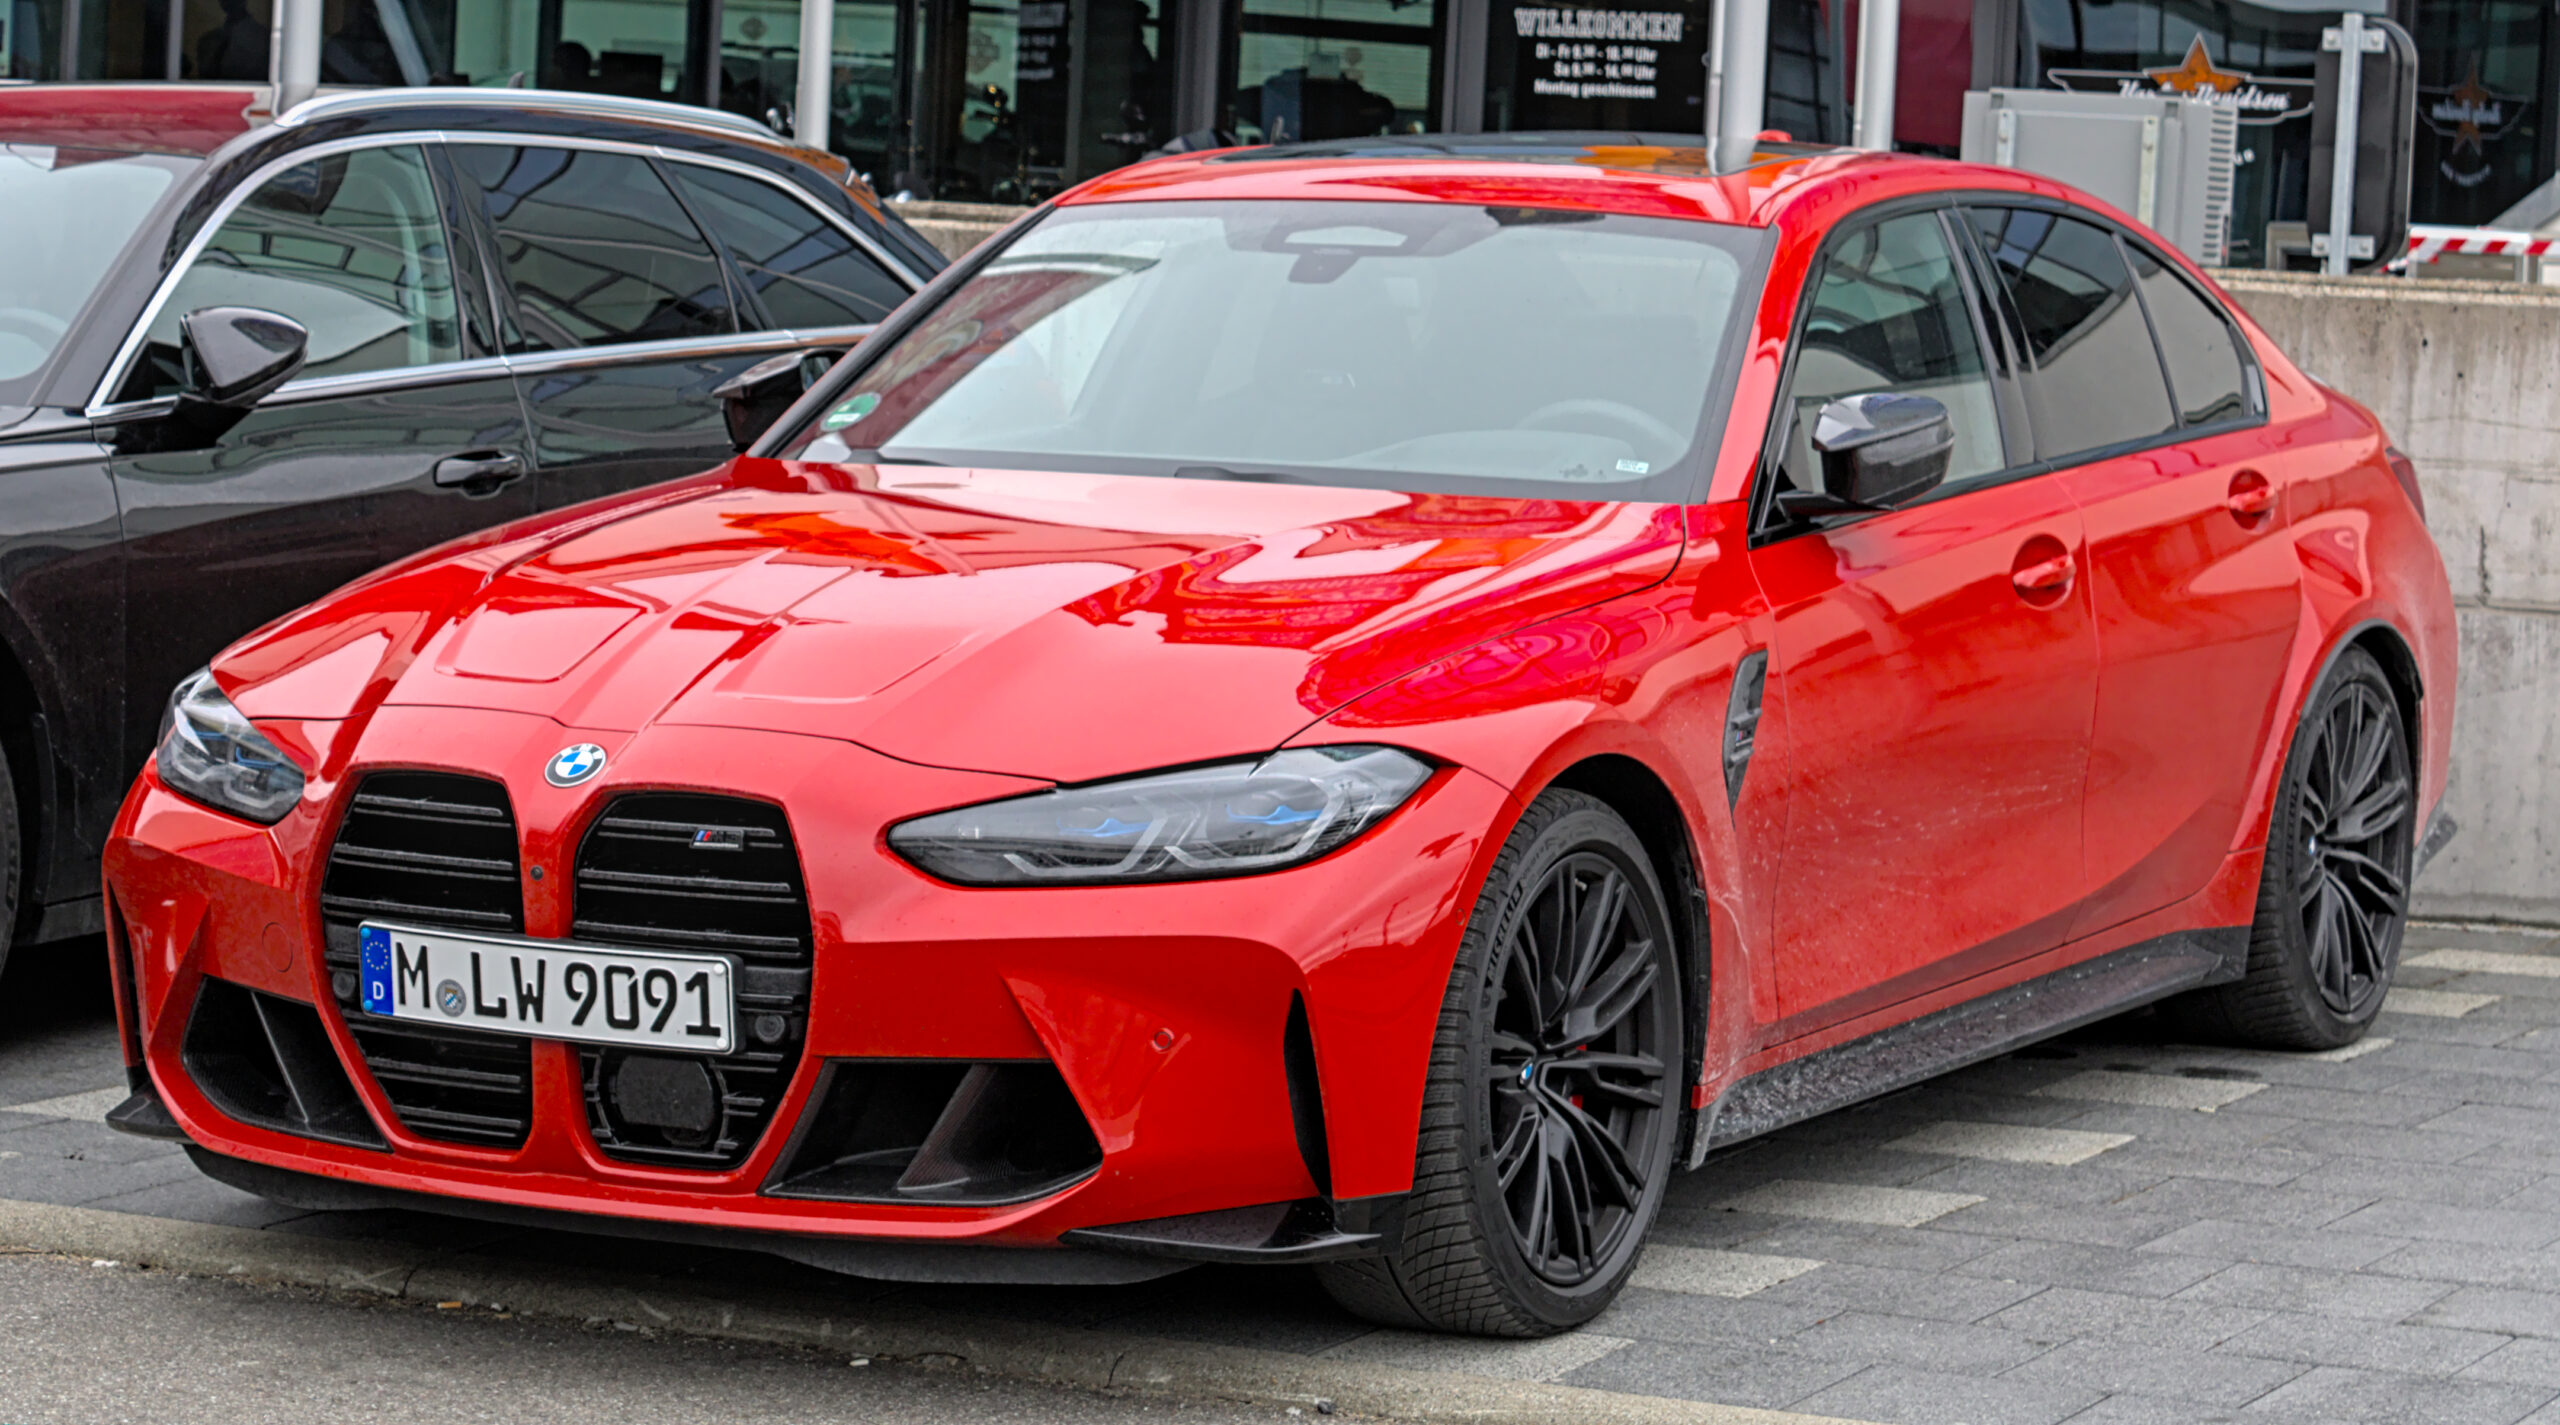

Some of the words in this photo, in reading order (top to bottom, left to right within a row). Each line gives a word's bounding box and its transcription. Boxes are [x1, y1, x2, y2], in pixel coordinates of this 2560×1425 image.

[1514, 8, 1683, 41] WILLKOMMEN
[1635, 47, 1657, 62] Uhr
[1554, 61, 1570, 77] Sa
[1634, 65, 1657, 80] Uhr
[1534, 79, 1579, 98] Montag
[1581, 82, 1657, 98] geschlossen
[373, 982, 385, 1000] D
[396, 942, 430, 1008] M
[471, 951, 546, 1023] LW
[564, 961, 721, 1037] 9091
